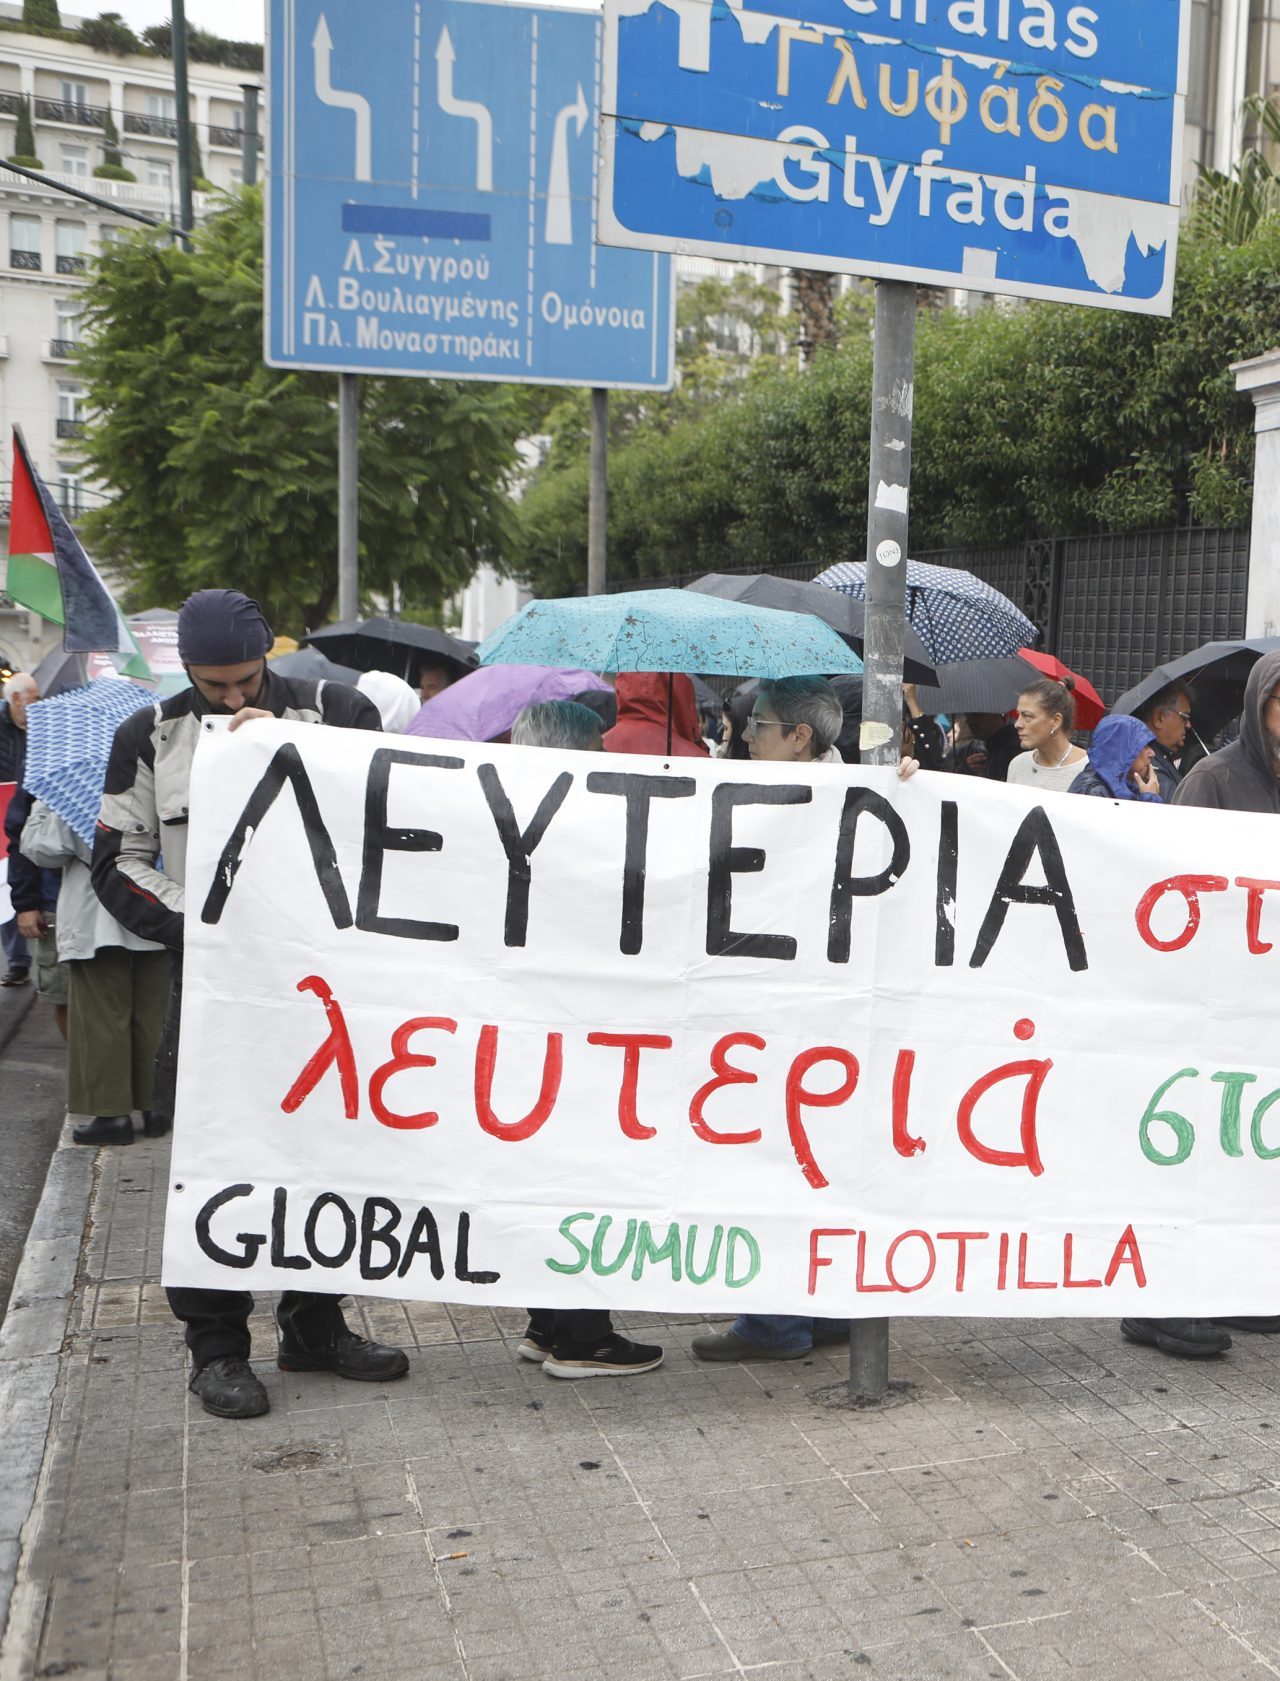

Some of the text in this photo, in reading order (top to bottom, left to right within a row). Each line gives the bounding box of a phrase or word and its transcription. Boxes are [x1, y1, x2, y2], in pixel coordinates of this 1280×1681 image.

[843, 0, 1100, 59] aias
[776, 25, 1118, 154] Γλυφάδα
[775, 124, 1082, 240] Glyfada
[338, 276, 519, 328] Βουλιαγμένης
[373, 238, 490, 281] Συγγρού
[355, 315, 521, 362] Μοναστηράκι
[541, 290, 647, 331] Ομόνοια
[200, 741, 1094, 972] ΛΕΥΤΕΡΙΑ
[280, 975, 1054, 1190] λευτεριά
[195, 1183, 1147, 1295] GLOBAL SUMUD FLOTILLA
